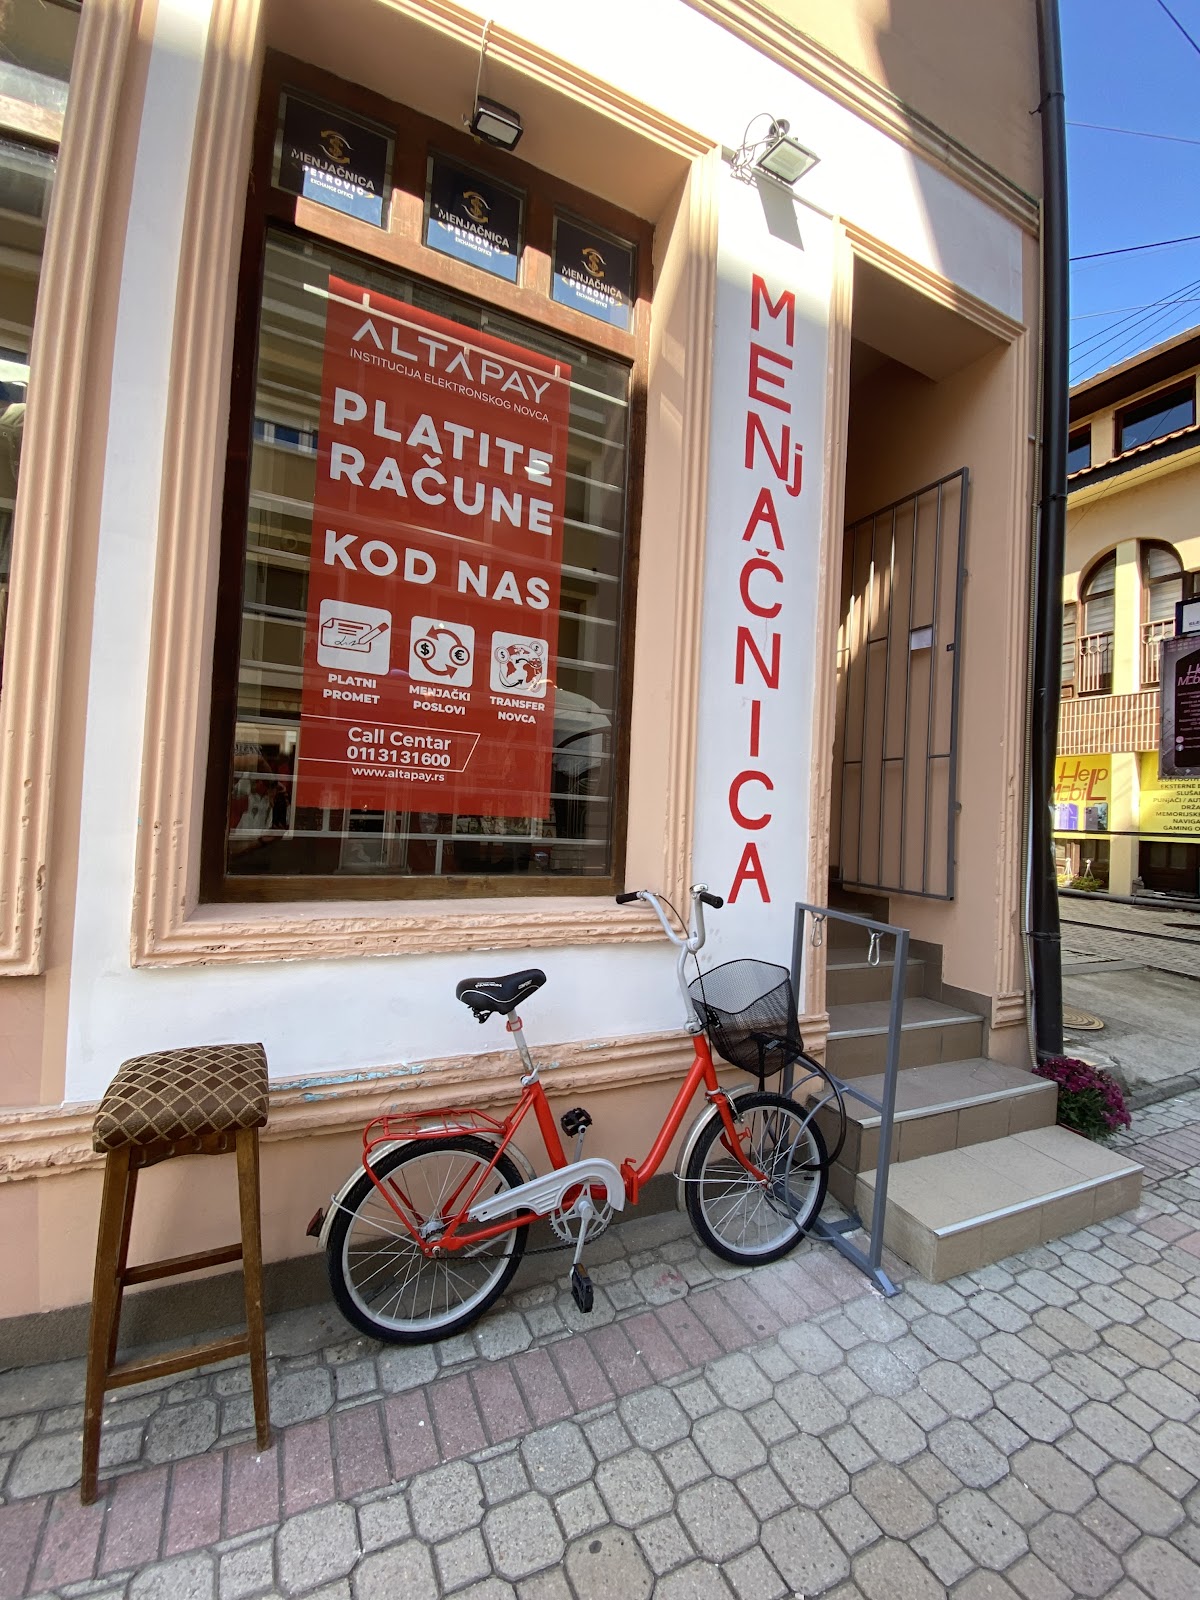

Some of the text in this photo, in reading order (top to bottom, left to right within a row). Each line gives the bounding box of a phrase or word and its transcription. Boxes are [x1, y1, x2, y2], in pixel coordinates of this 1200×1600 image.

[291, 149, 375, 190] MENJAČNICA
[310, 178, 354, 200] EXCHANGE OFFICE
[438, 209, 510, 248] MENJAČNICA
[562, 266, 622, 299] MENJAČNICA
[352, 318, 550, 404] ALTAPAY
[350, 348, 549, 422] INSTITUCIJA ELEKTRONSKOG NOVCA
[333, 387, 554, 487] PLATITE
[329, 442, 554, 536] RAČUNE
[324, 530, 550, 610] KOD NAS
[328, 673, 377, 689] PLATNI
[409, 684, 470, 702] MENJAČKI
[323, 688, 380, 704] PROMET
[413, 700, 466, 716] POSLOVI
[490, 696, 546, 712] TRANSFER
[498, 711, 536, 724] NOVCA
[348, 727, 452, 751] Call Centar
[352, 767, 445, 782] www.altapay.rs
